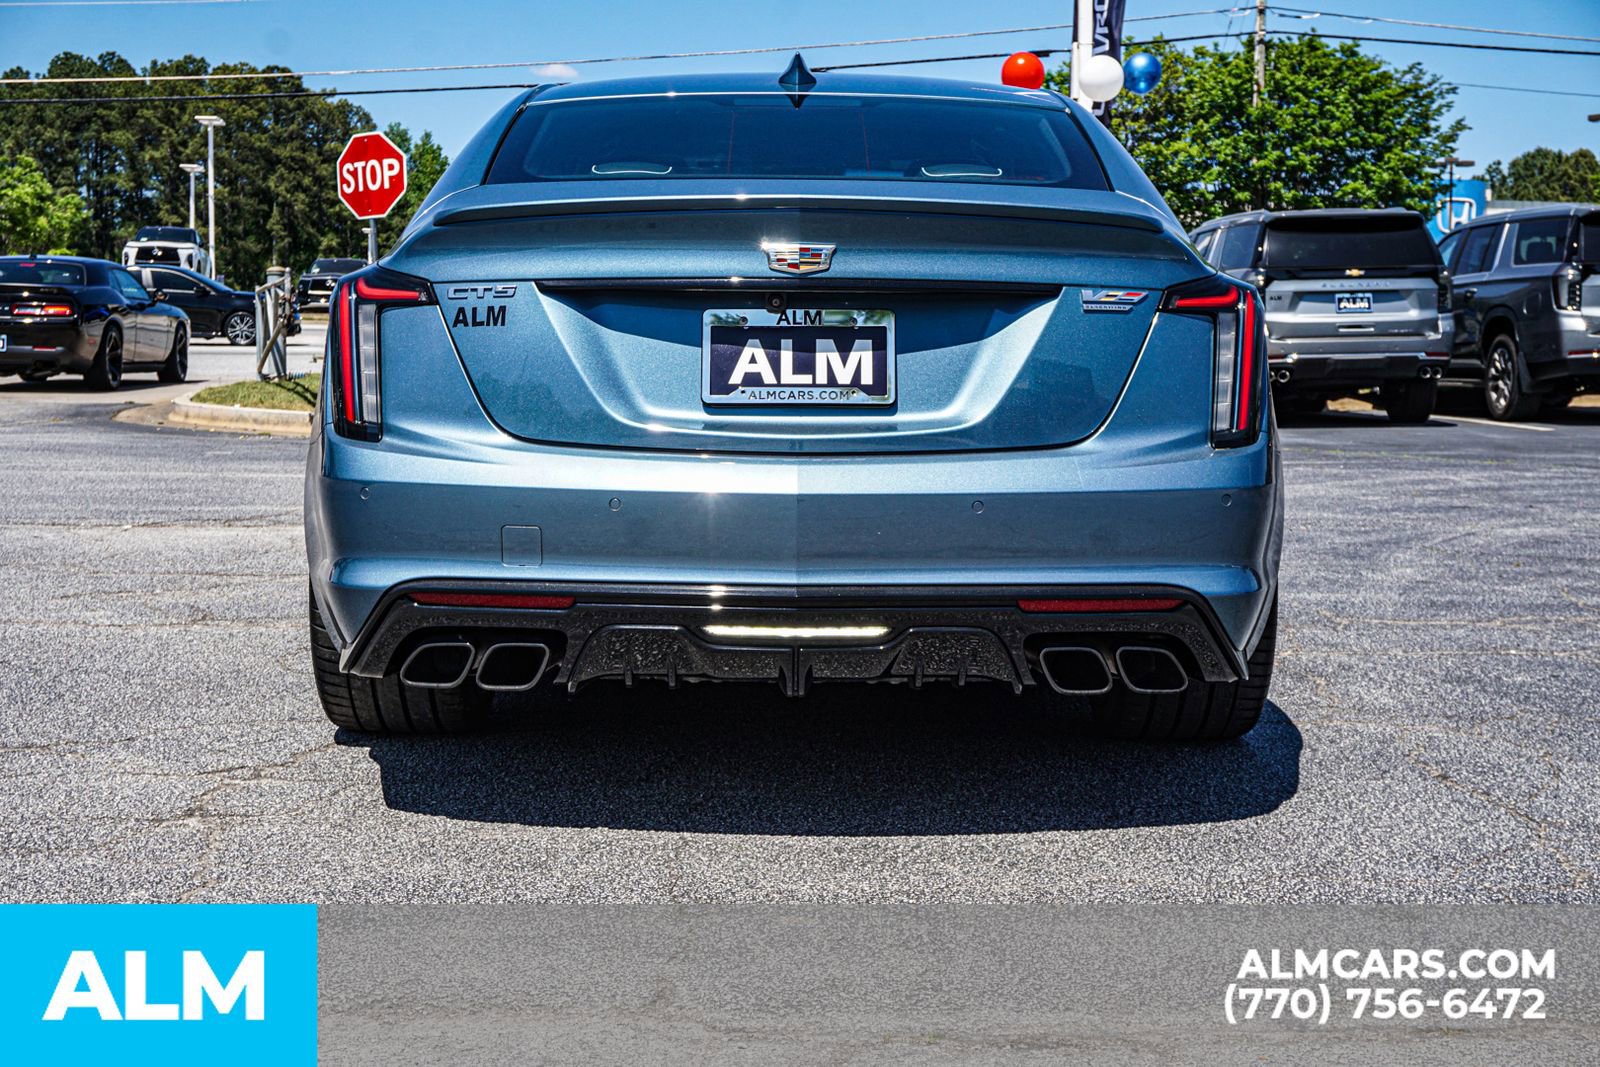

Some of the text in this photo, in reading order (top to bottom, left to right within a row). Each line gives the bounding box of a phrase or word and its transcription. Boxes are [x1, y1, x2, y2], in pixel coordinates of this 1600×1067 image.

[342, 158, 400, 194] STOP
[1339, 298, 1369, 309] ALM
[452, 305, 507, 328] ALM
[776, 310, 823, 326] ALM
[728, 338, 873, 385] ALM
[748, 390, 850, 400] ALMCARS.COM
